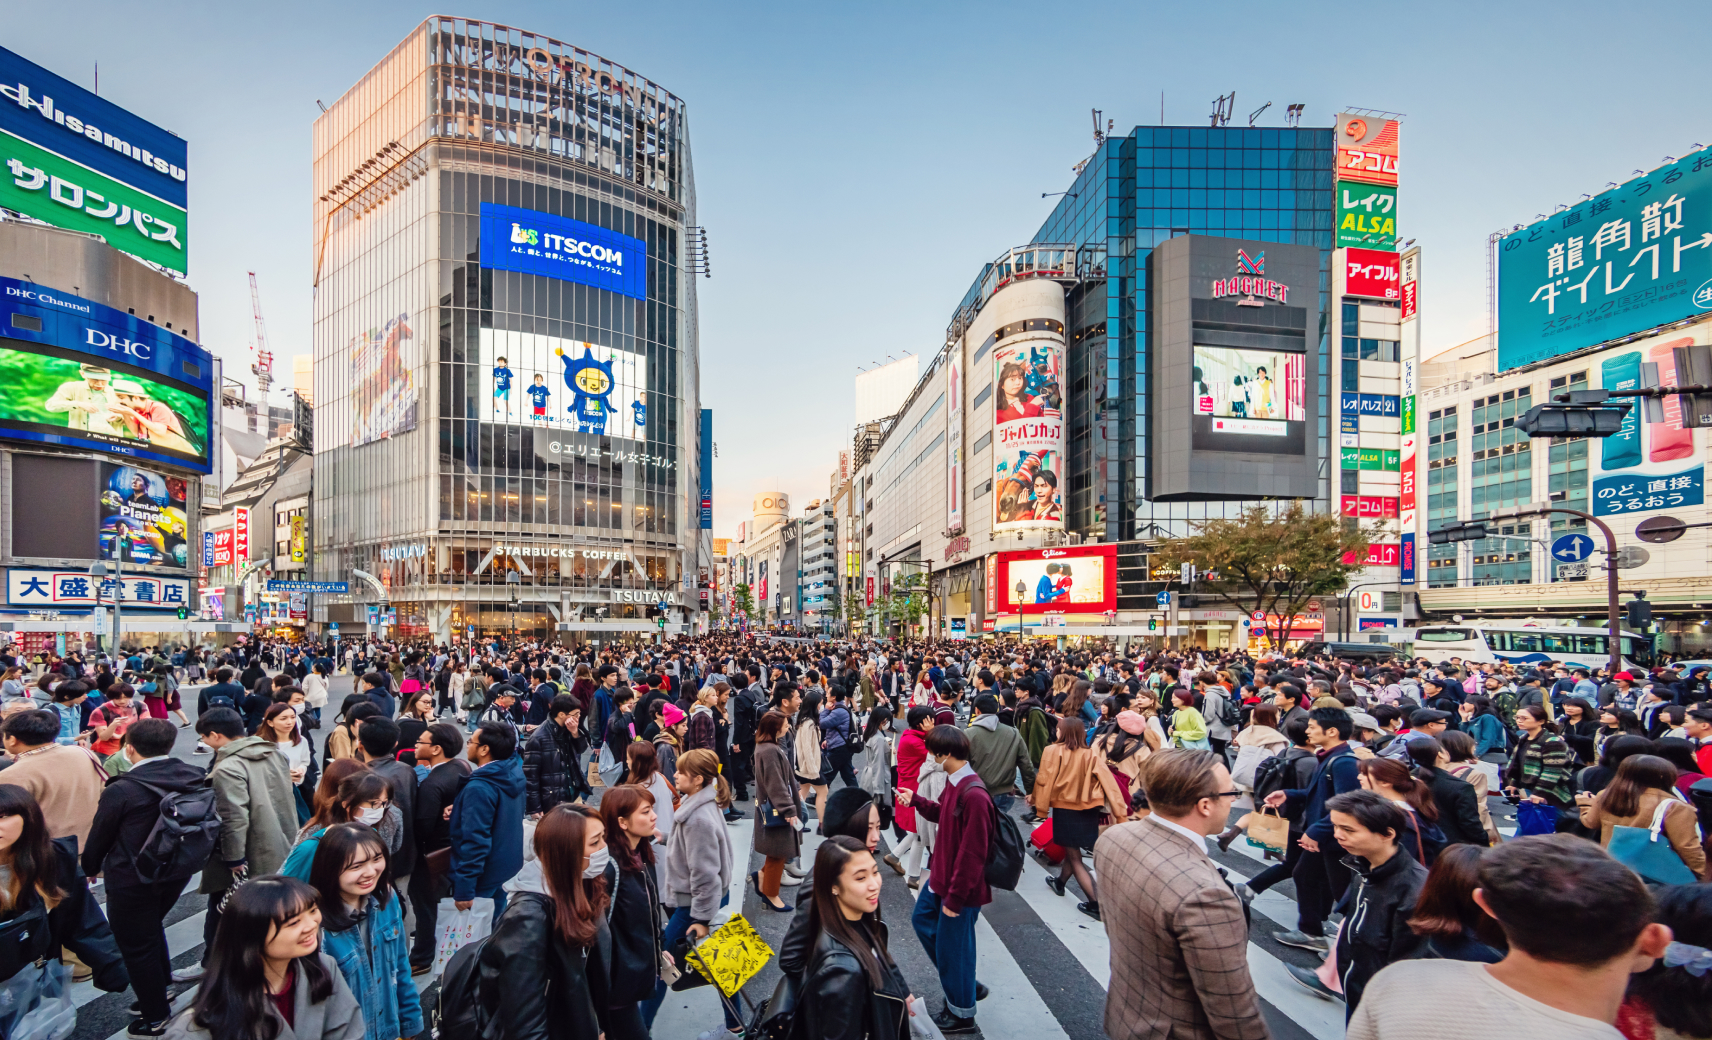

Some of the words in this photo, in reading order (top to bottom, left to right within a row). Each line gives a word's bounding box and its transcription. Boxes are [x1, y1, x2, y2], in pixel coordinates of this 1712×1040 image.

[0, 82, 186, 182] Hisamitsu
[1346, 150, 1399, 174] アコム
[6, 157, 181, 250] サロンパス
[1342, 189, 1394, 214] レイク
[1340, 212, 1394, 236] ALSA
[1547, 193, 1686, 279] 龍角散
[1348, 262, 1398, 281] アイフル
[6, 286, 36, 300] DHC
[38, 294, 90, 314] Channel
[1212, 275, 1290, 304] MAGNET
[1385, 288, 1398, 298] 8F
[1405, 289, 1414, 316] アイフル
[1542, 299, 1615, 332] スティック
[85, 327, 151, 360] DHC
[1342, 398, 1396, 413] レオパレス21
[1000, 422, 1062, 443] ジャパンカップ
[111, 446, 131, 454] DHC
[1341, 453, 1358, 461] レイク
[1360, 454, 1379, 462] ALSA
[1387, 456, 1398, 465] 5F
[1597, 475, 1702, 500] のど、直接、
[127, 500, 160, 513] teamLab
[701, 488, 711, 522] SEIBU
[1345, 500, 1382, 513] アコム
[1606, 493, 1684, 513] うるおう
[119, 505, 172, 525] Planets
[136, 520, 159, 528] TOKYO
[237, 512, 248, 551] カラオケ
[380, 543, 426, 561] TSUTAYA
[495, 545, 576, 559] STARBUCKS
[581, 549, 627, 561] COFFEE
[1042, 549, 1067, 559] Glico
[1404, 541, 1413, 571] PROMISE
[613, 589, 677, 605] TSUTAYA
